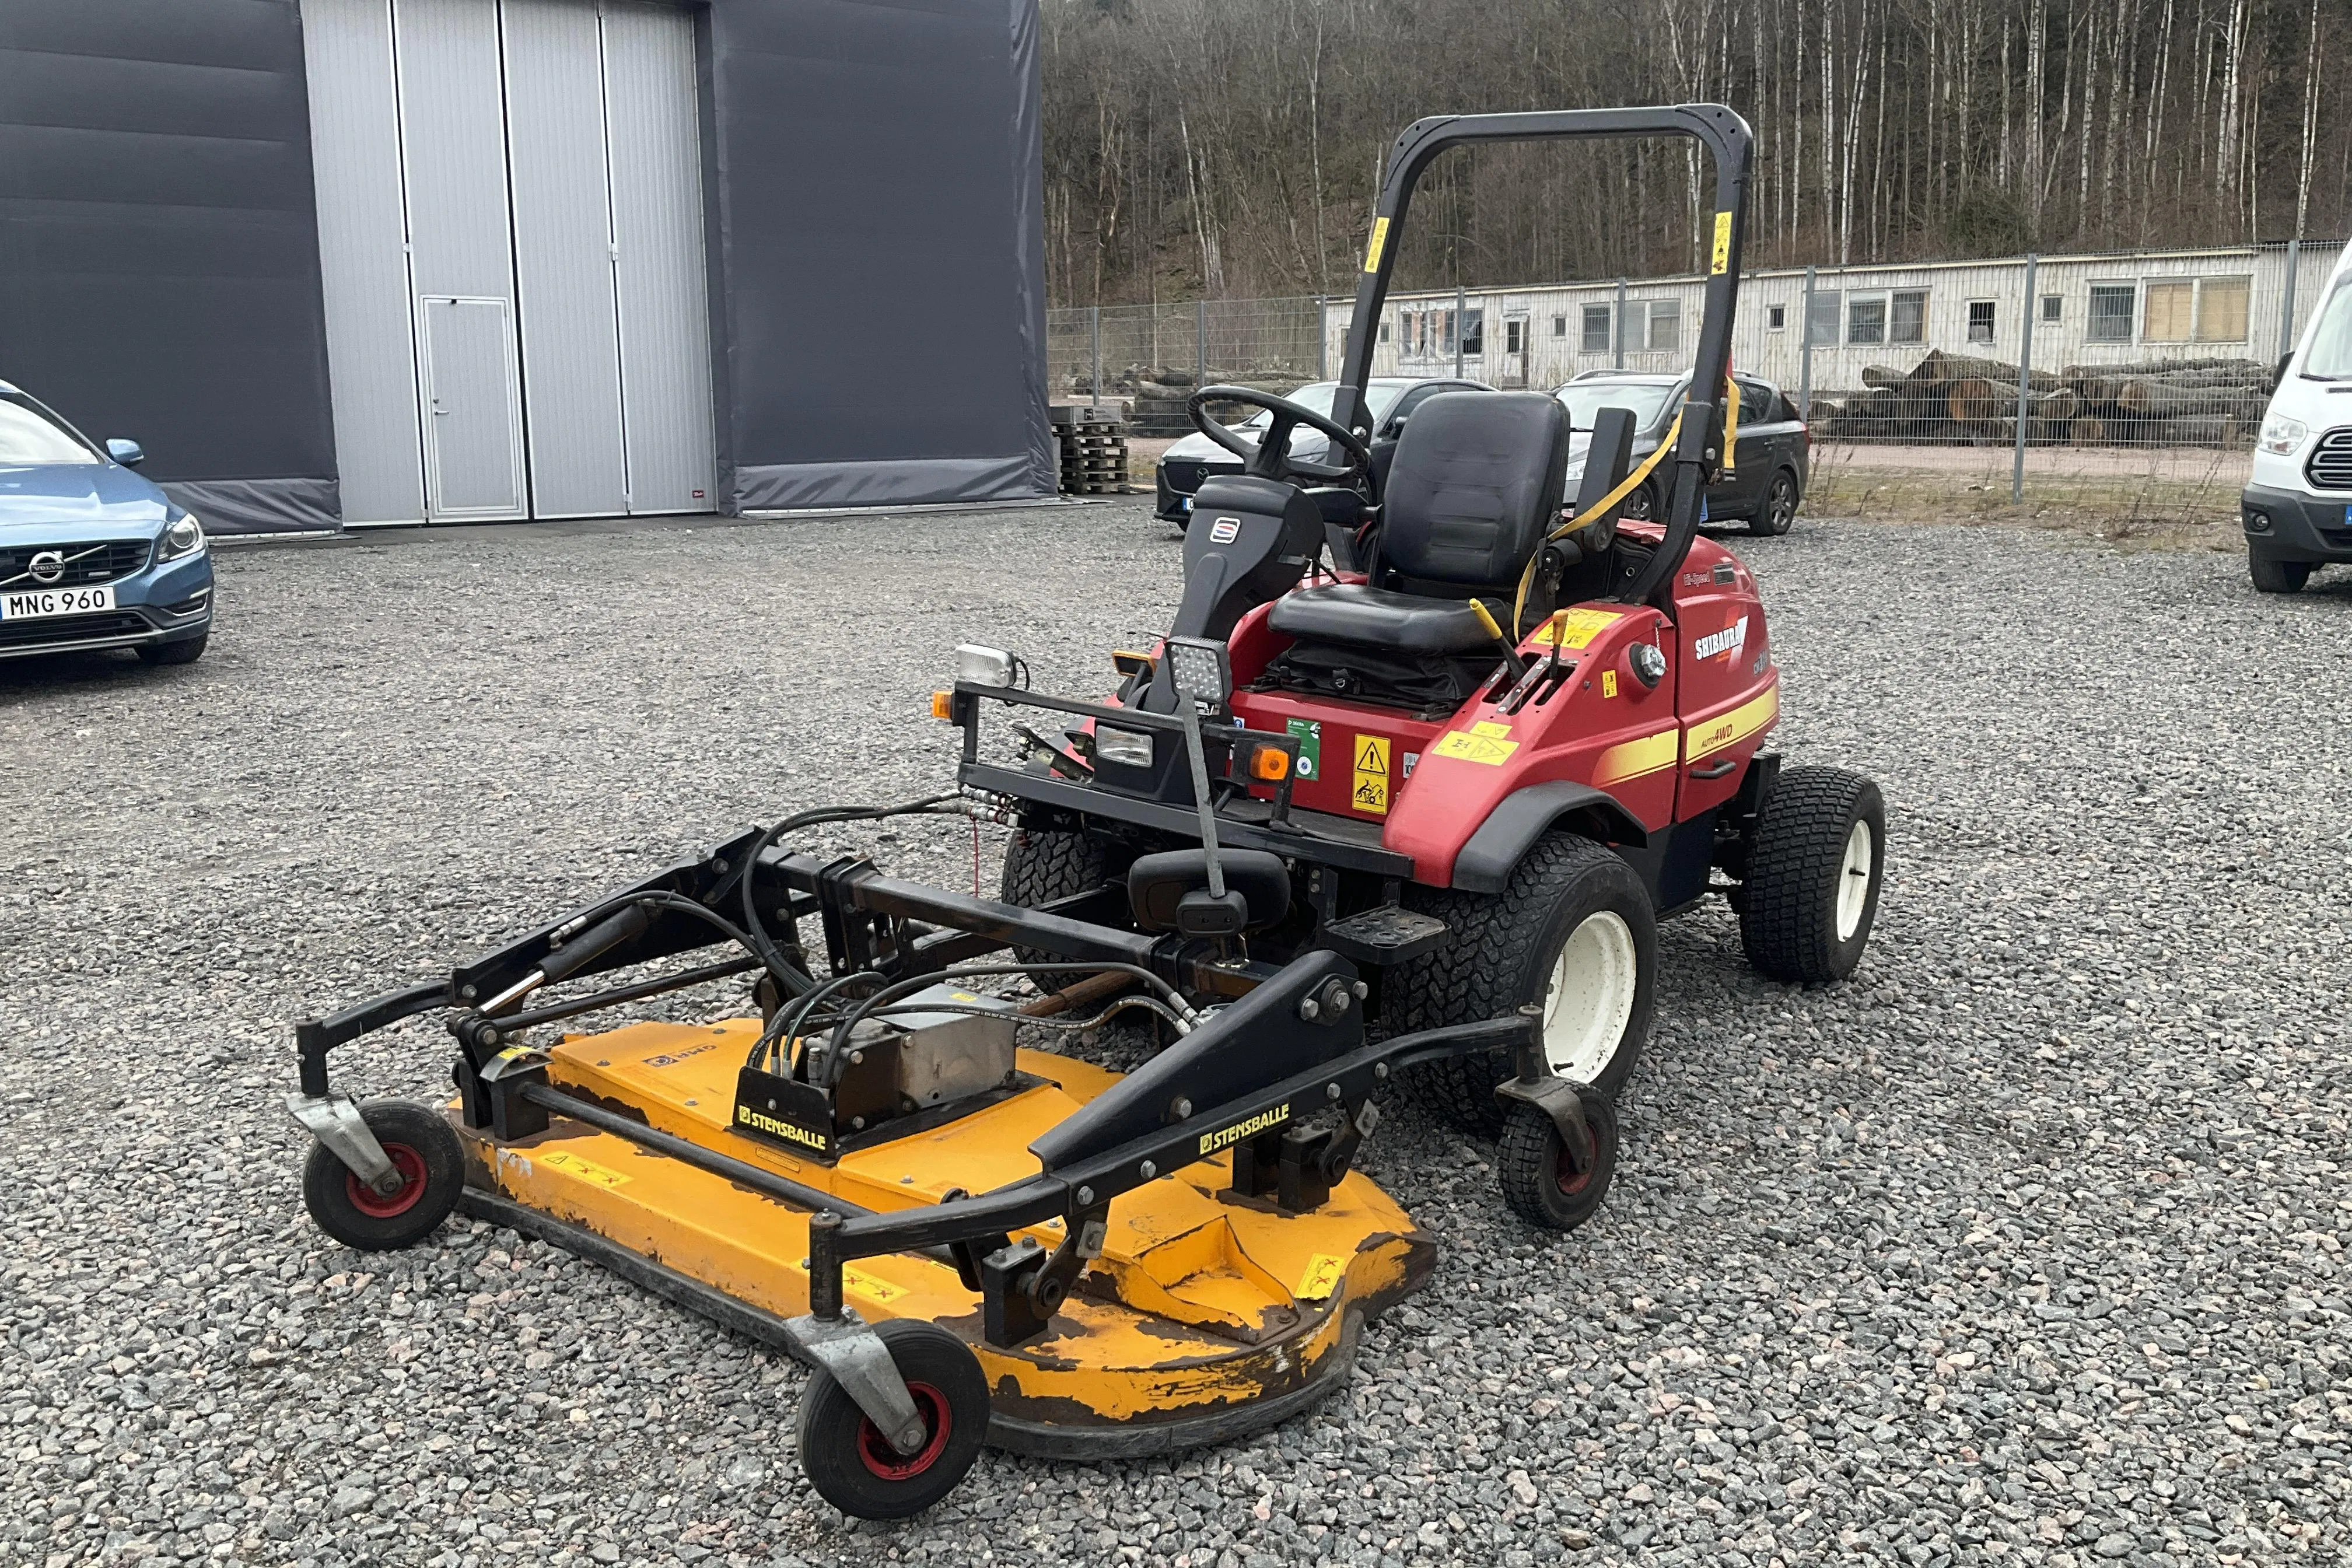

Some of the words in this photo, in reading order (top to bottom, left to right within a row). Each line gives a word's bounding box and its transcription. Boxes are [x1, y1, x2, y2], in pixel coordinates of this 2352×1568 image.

[9, 594, 54, 616] MNG
[61, 590, 105, 611] 960
[1695, 625, 1742, 660] SHIBAURA
[751, 1112, 826, 1150] STENSBALLE
[1213, 1103, 1289, 1149] STENSBALLE
